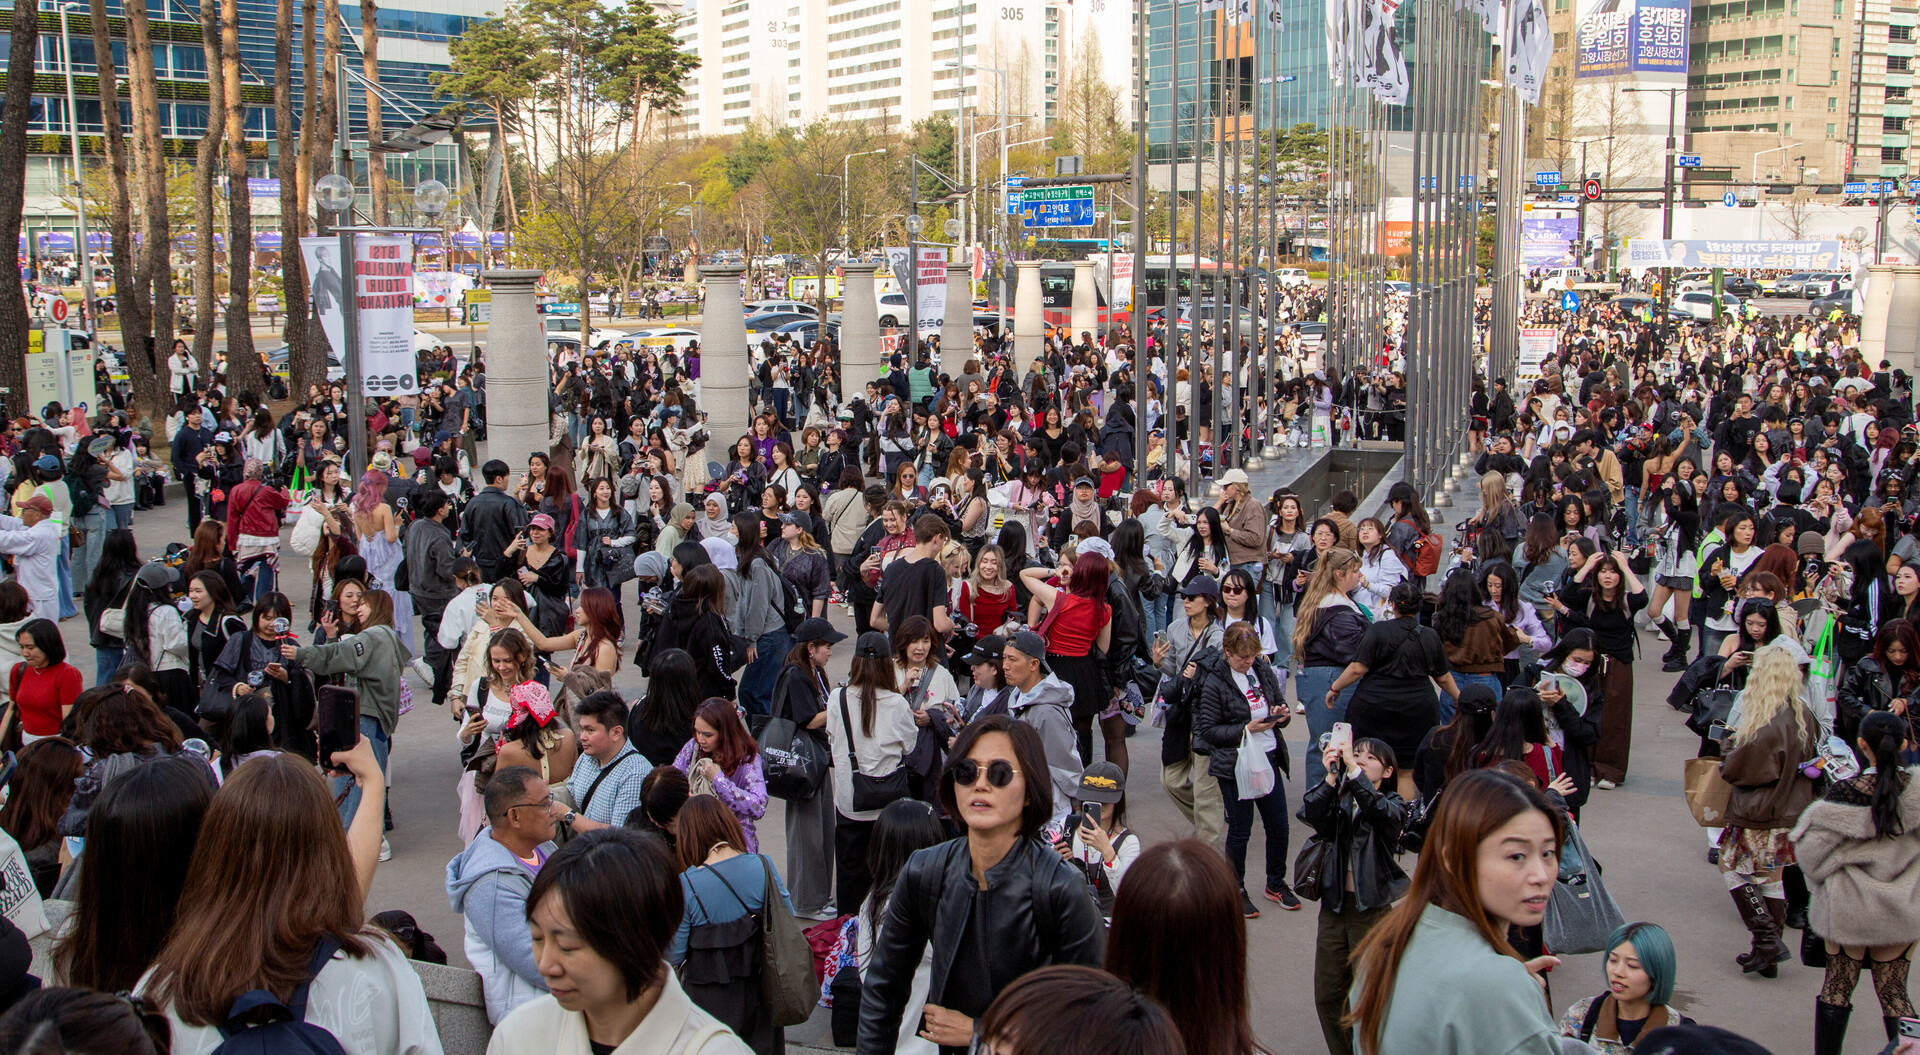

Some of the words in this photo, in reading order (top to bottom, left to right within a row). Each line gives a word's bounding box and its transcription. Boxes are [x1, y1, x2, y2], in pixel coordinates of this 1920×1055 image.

[1001, 7, 1024, 20] 305
[1639, 6, 1687, 27] 장제환
[771, 38, 787, 48] 303
[1580, 28, 1629, 52] 후원회
[1638, 26, 1684, 47] 후원회
[1580, 48, 1628, 64] 고양시장선거
[1638, 45, 1684, 59] 고양시장선거
[1587, 185, 1597, 195] 60
